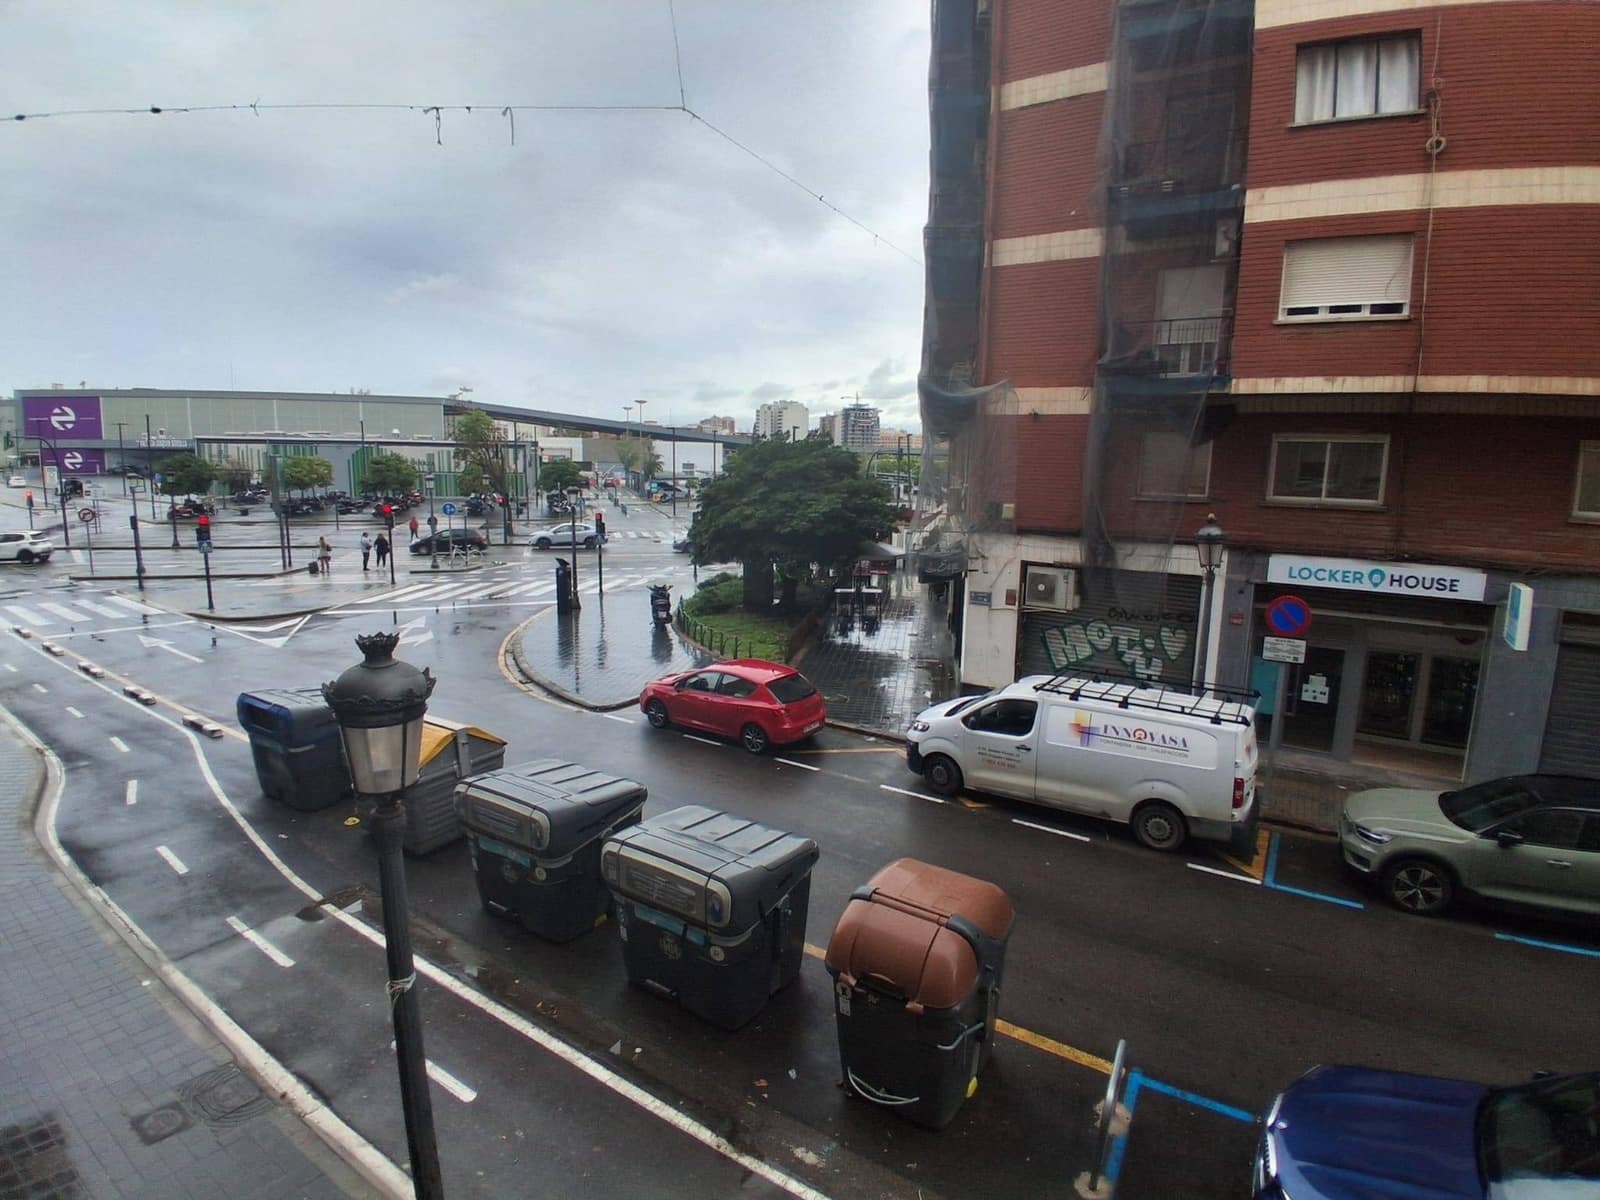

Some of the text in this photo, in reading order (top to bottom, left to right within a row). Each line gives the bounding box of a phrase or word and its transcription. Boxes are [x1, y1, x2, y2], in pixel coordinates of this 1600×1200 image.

[1288, 566, 1460, 592] LOCKER HOUSE
[1103, 724, 1189, 748] INNOVASA
